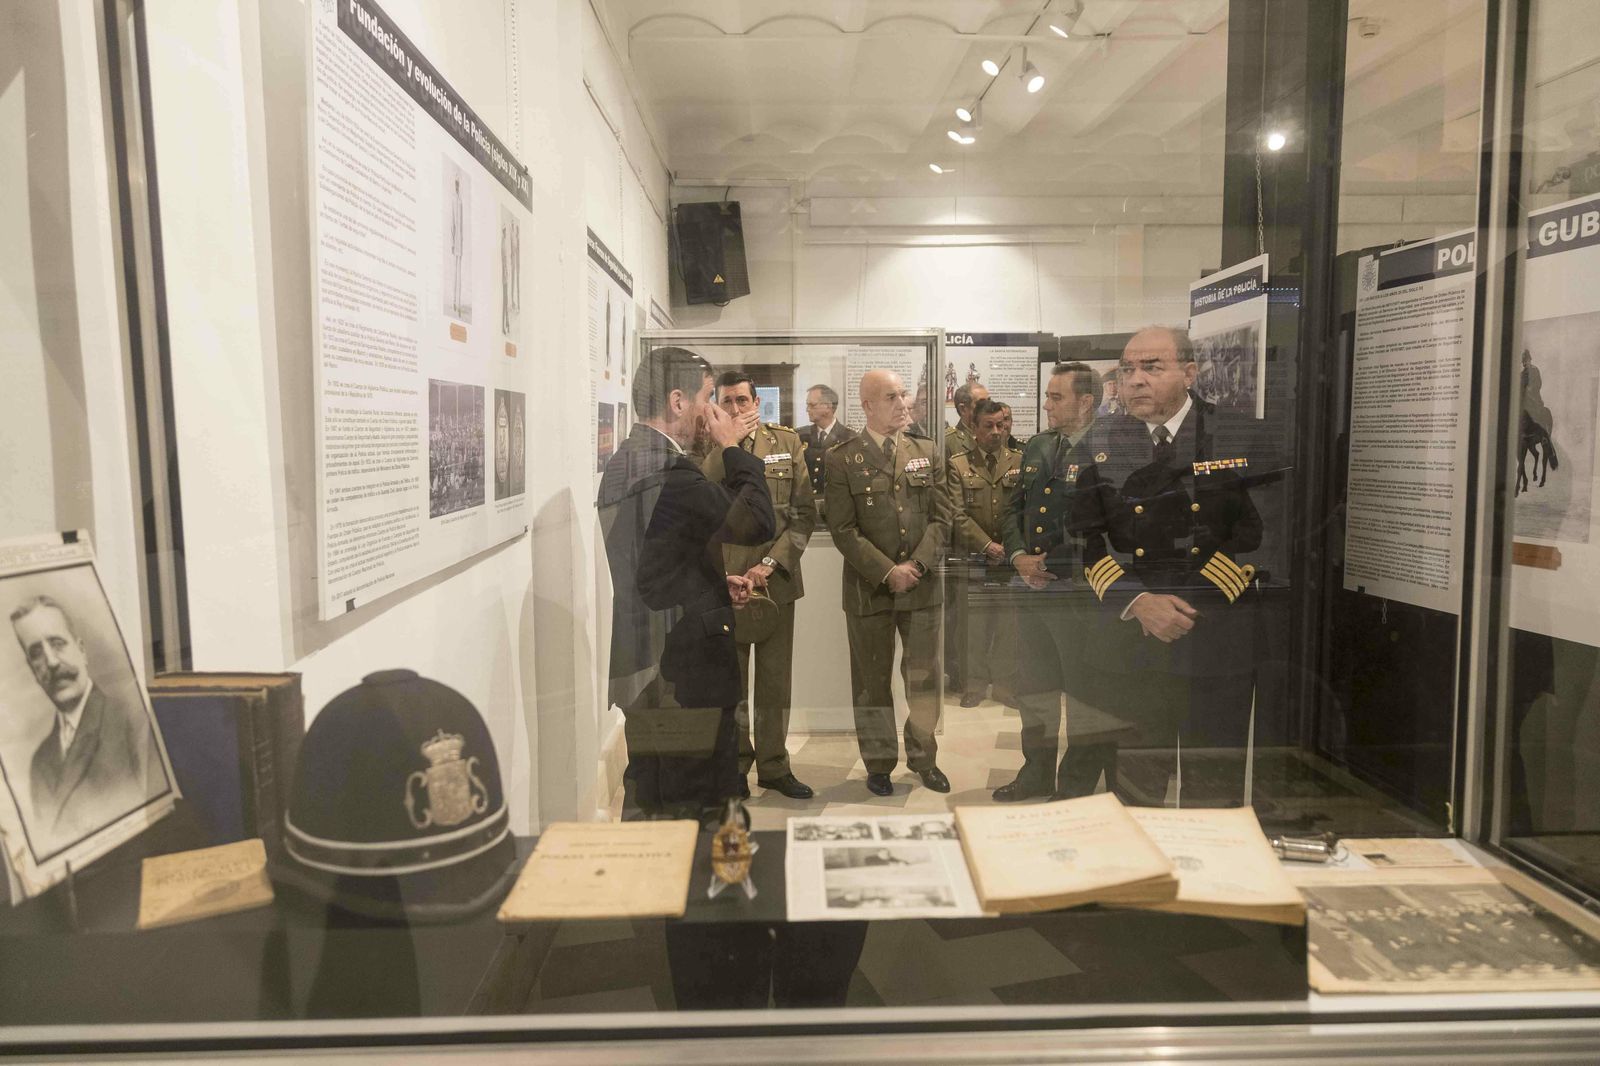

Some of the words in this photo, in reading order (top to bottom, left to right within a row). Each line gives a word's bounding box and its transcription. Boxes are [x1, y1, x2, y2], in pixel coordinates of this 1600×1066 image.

[406, 56, 413, 78] y
[414, 65, 453, 114] evolución
[453, 104, 463, 125] de
[463, 112, 470, 134] la
[1538, 210, 1600, 247] GUB
[1194, 293, 1216, 308] HISTORIA
[1217, 289, 1226, 301] DE
[1225, 288, 1233, 298] LA
[1234, 278, 1257, 295] POLICÍA
